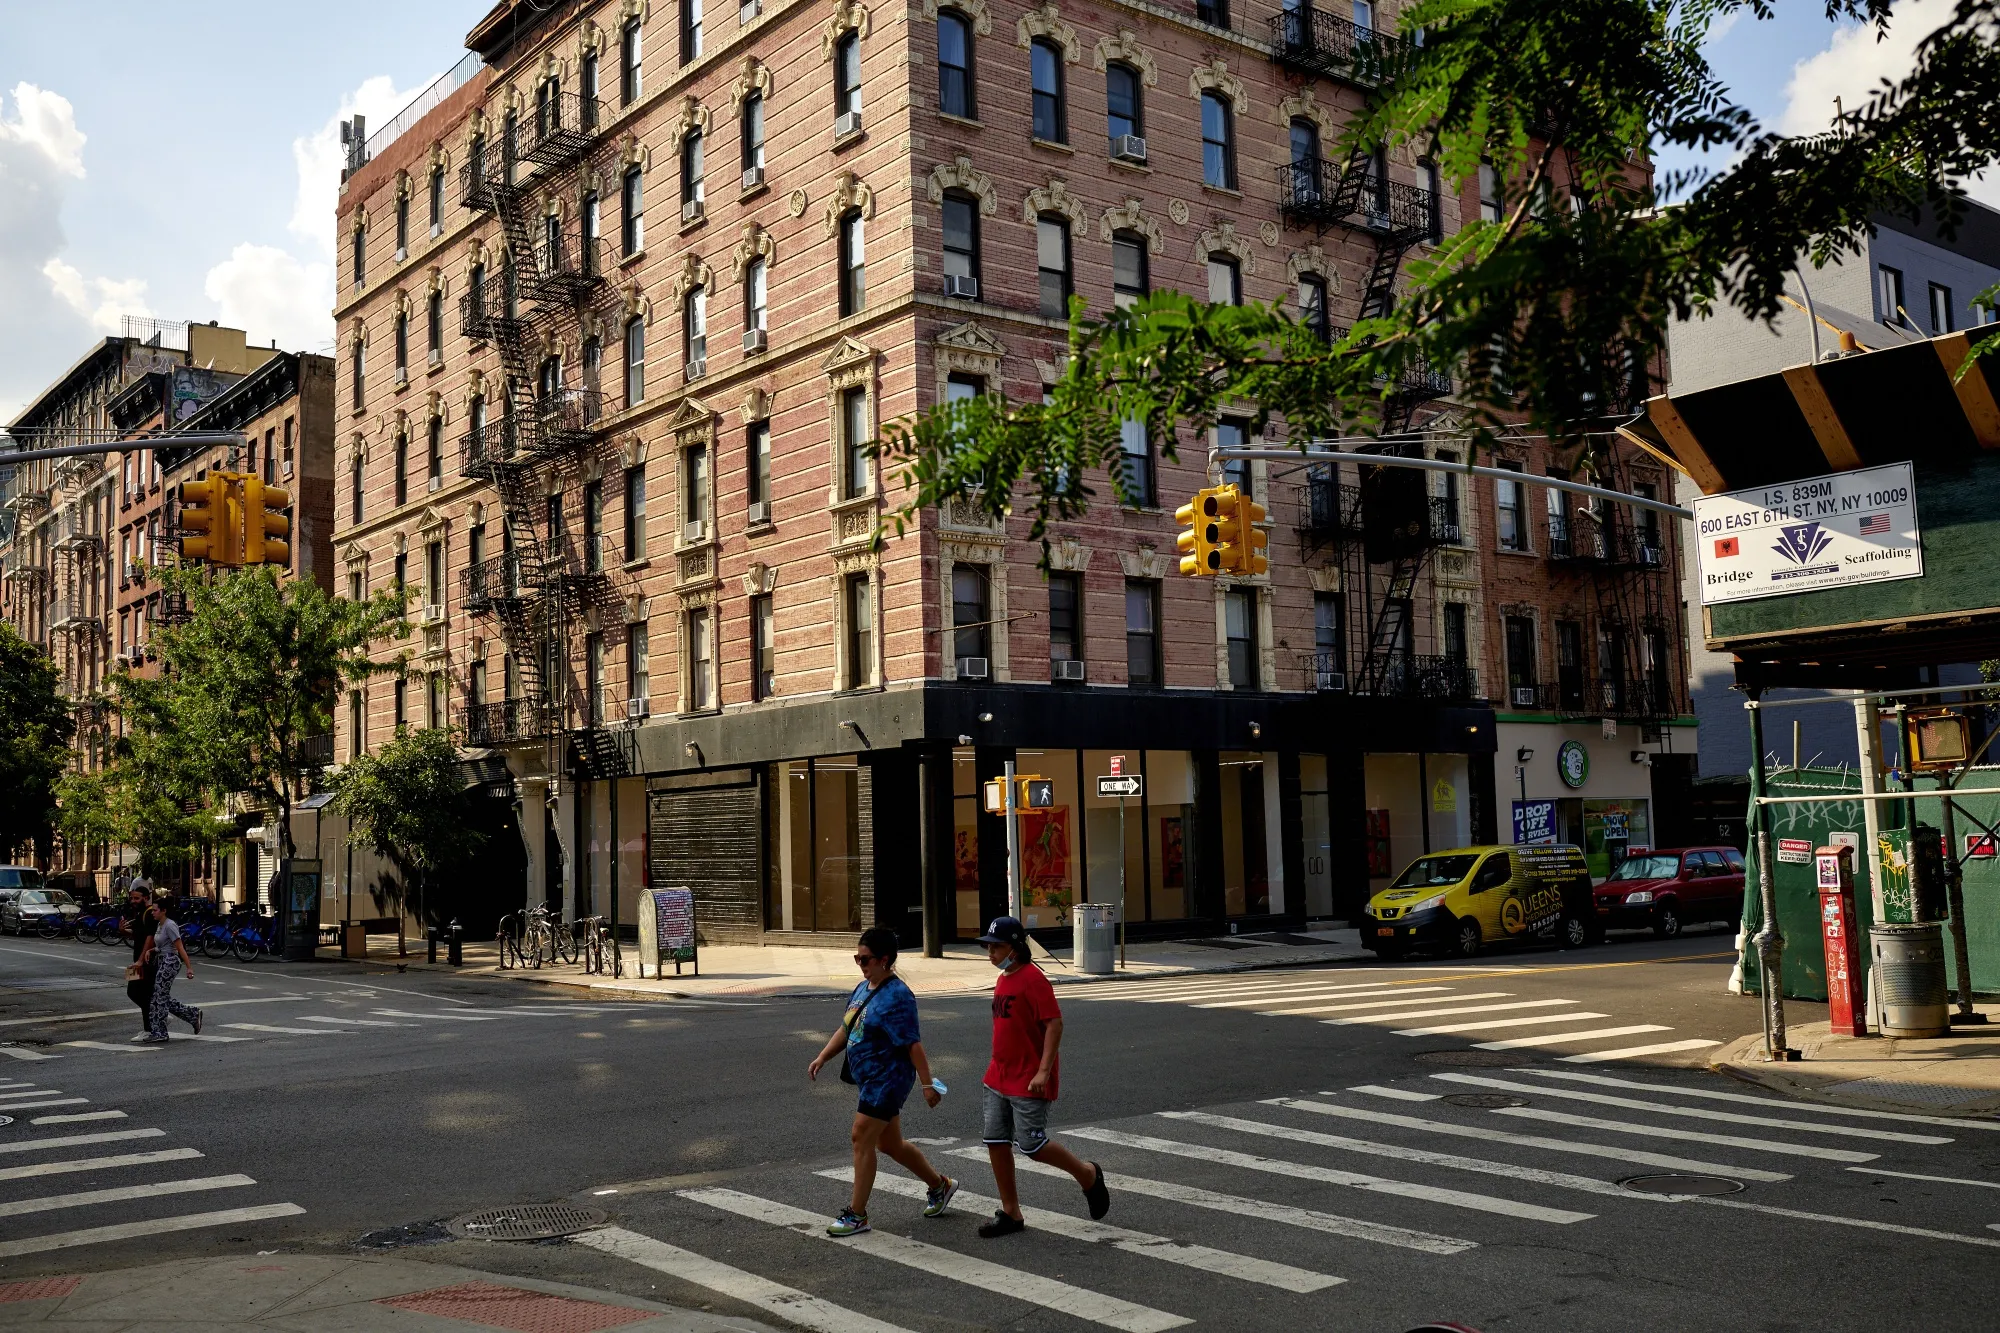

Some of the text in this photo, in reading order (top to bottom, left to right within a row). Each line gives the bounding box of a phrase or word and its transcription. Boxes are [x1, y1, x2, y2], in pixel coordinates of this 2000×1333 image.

[1764, 482, 1832, 506] I.S. 839M
[1701, 487, 1908, 534] 600 EAST 6TH ST. NY, NY 10009
[1844, 547, 1912, 565] Scaffolding
[1707, 570, 1754, 585] Bridge
[1785, 580, 1805, 590] please
[1805, 578, 1818, 586] visit
[1103, 782, 1135, 791] ONE WAY
[1514, 803, 1552, 821] DROP
[1520, 815, 1548, 832] OFF
[1718, 824, 1731, 837] 62
[1518, 828, 1550, 841] SRVICE
[1604, 827, 1628, 838] OPEN
[1781, 842, 1809, 850] DANGER
[1501, 884, 1561, 934] QUEENS
[1524, 901, 1565, 924] MEDALLION
[1528, 912, 1561, 933] LEASING
